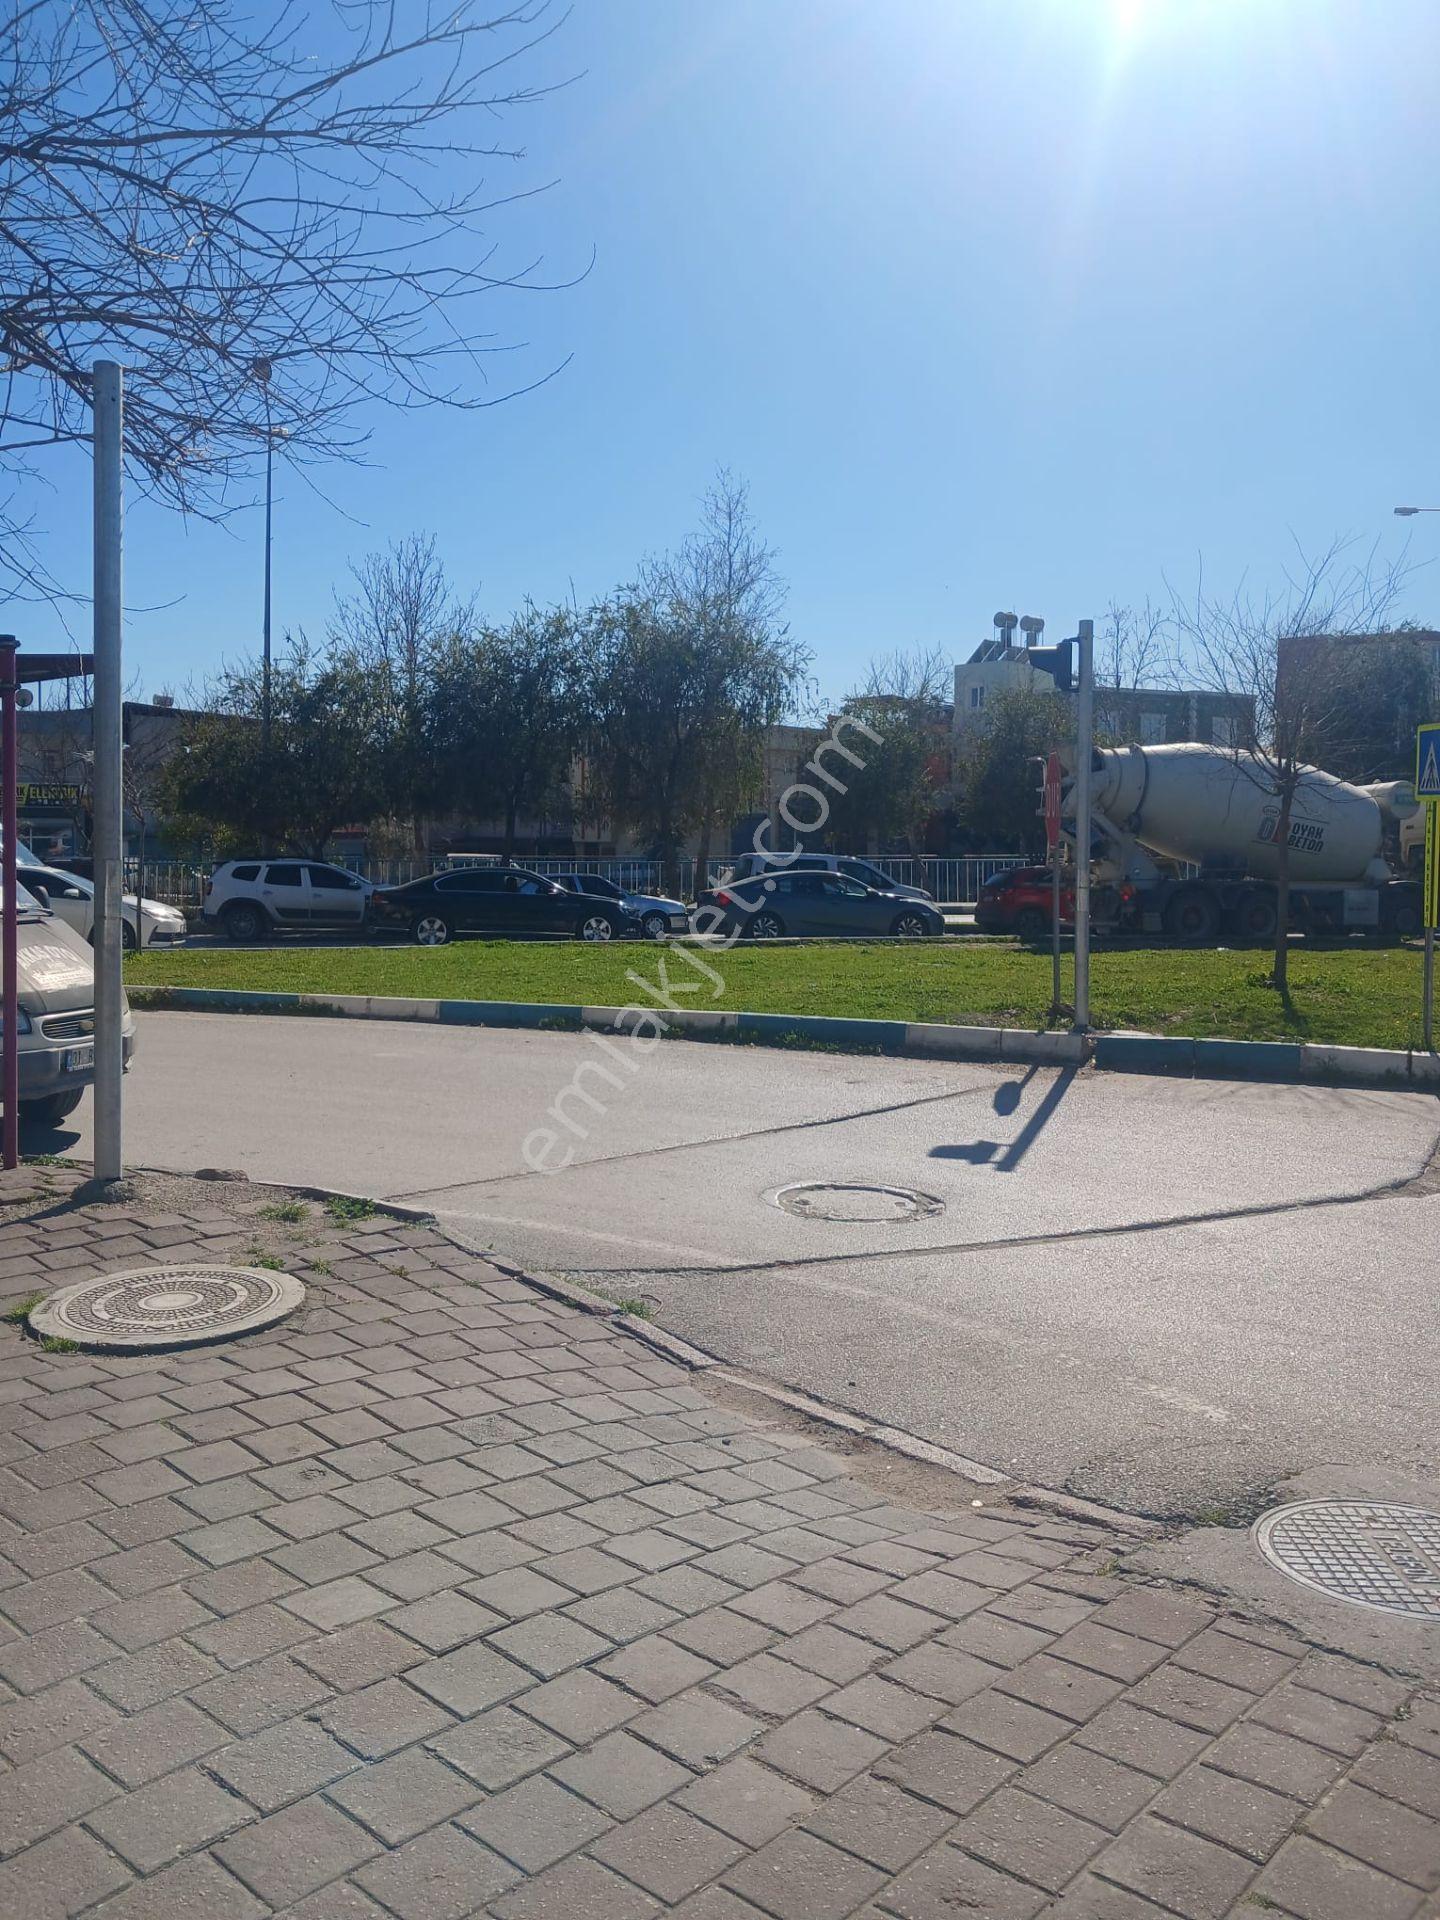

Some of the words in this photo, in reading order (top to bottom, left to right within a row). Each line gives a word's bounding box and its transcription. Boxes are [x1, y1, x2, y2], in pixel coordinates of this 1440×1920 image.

[1292, 822, 1324, 839] OYAK
[1288, 835, 1324, 852] BETON
[1372, 1534, 1440, 1584] TELEFON
